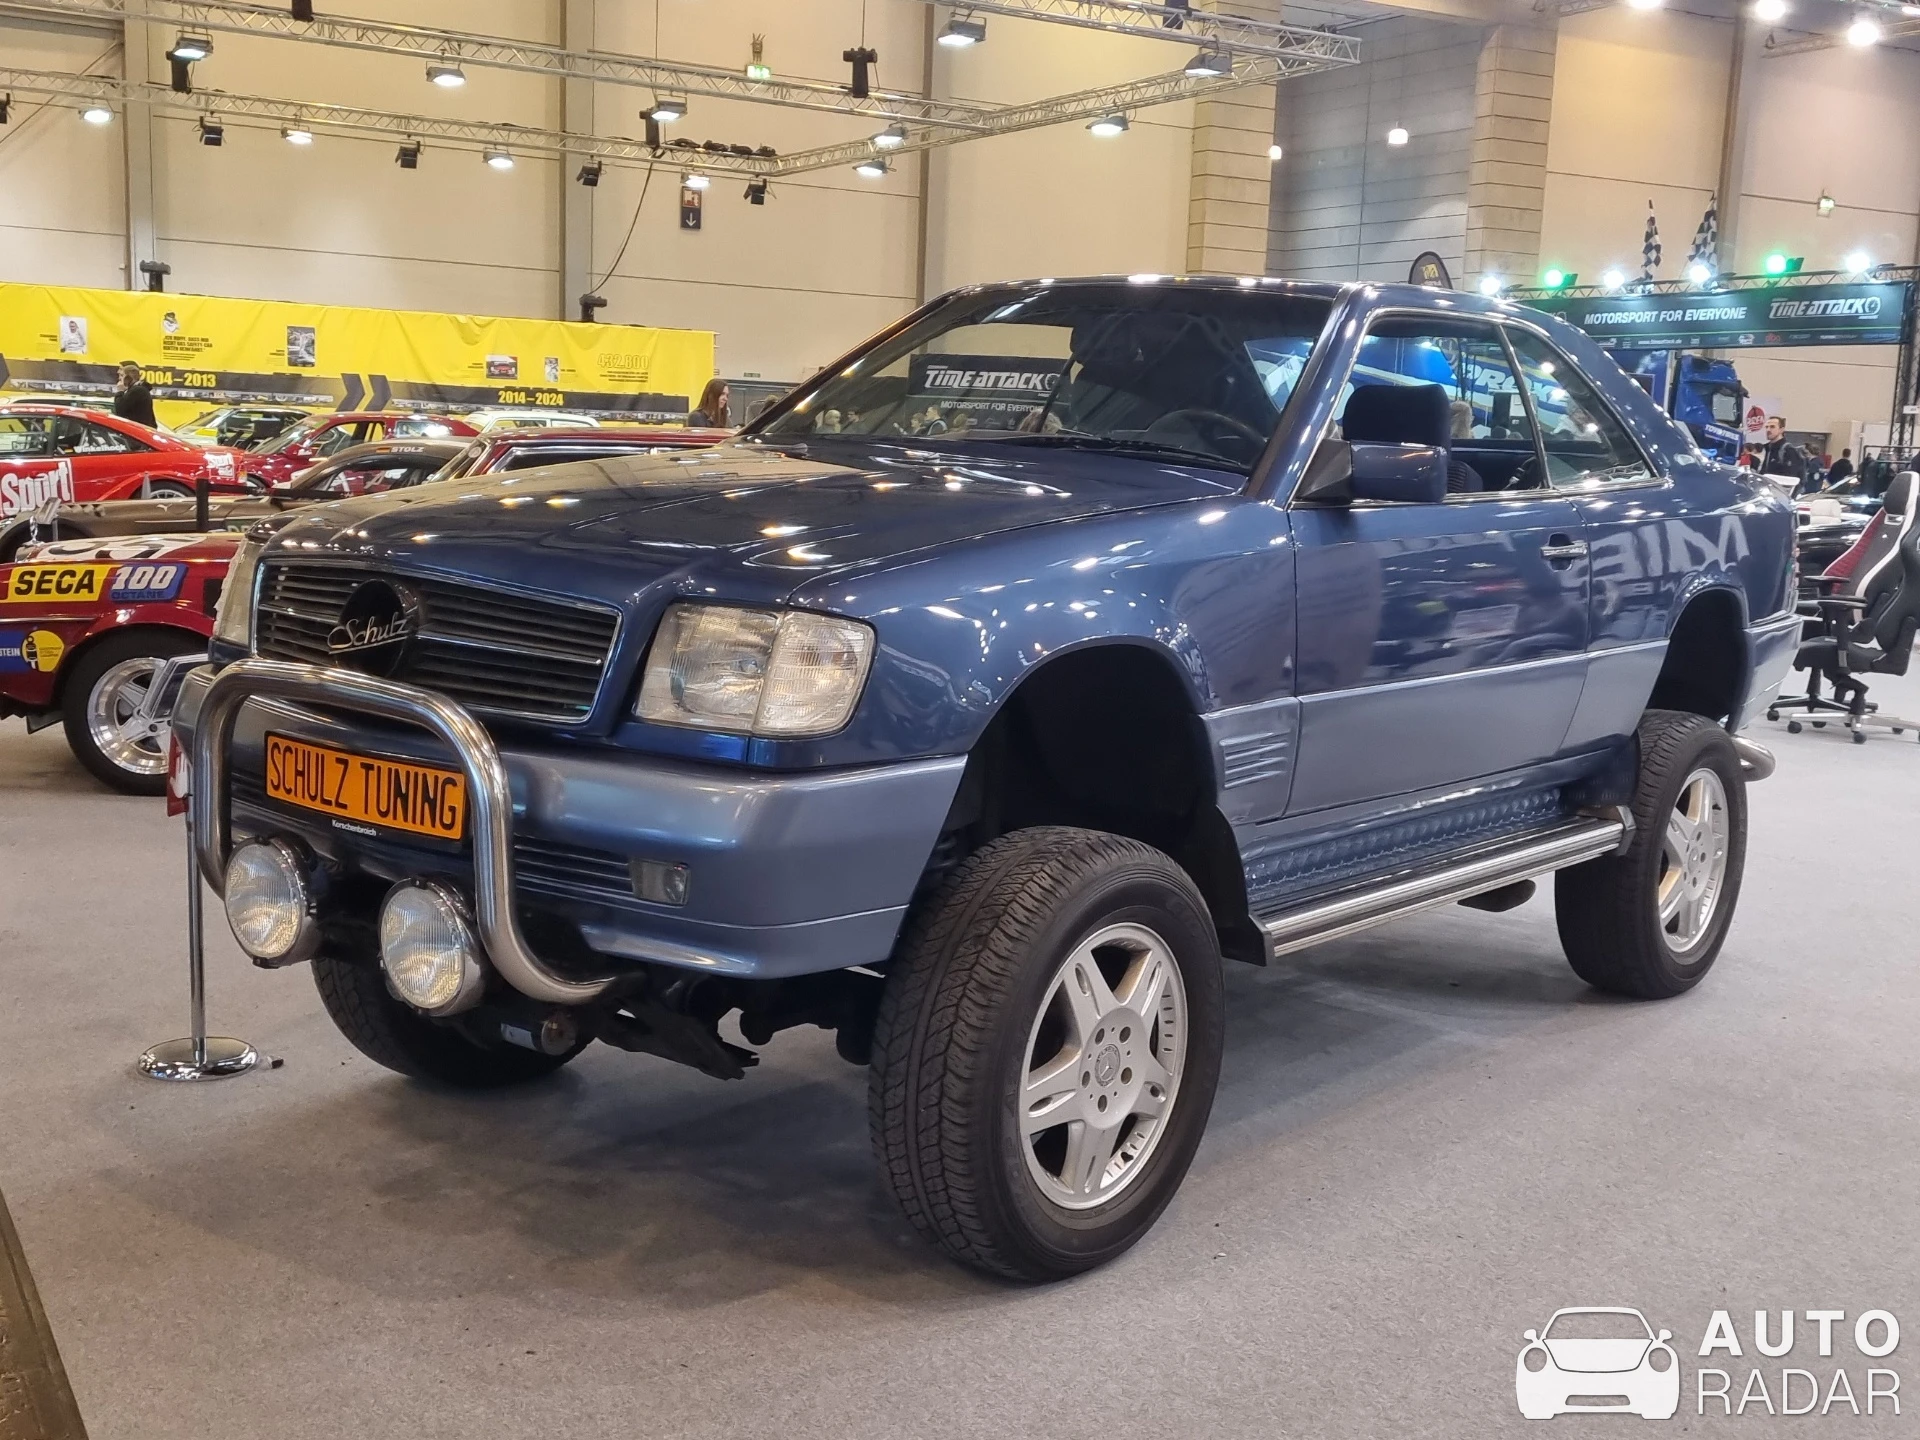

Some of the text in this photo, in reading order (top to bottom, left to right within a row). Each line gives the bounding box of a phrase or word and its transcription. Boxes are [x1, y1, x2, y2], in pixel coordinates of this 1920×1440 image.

[1584, 306, 1748, 325] MOTORSPORT FOR EVERYONE
[940, 400, 991, 410] MOTORSPORT
[991, 403, 1006, 411] FOR
[73, 444, 127, 454] Winkelhock
[1, 461, 71, 516] Sport
[14, 569, 95, 596] SECA
[111, 565, 178, 590] 100
[111, 590, 166, 600] OCTANE
[327, 611, 411, 652] Schulz
[270, 742, 458, 832] SCHULZ TUNING
